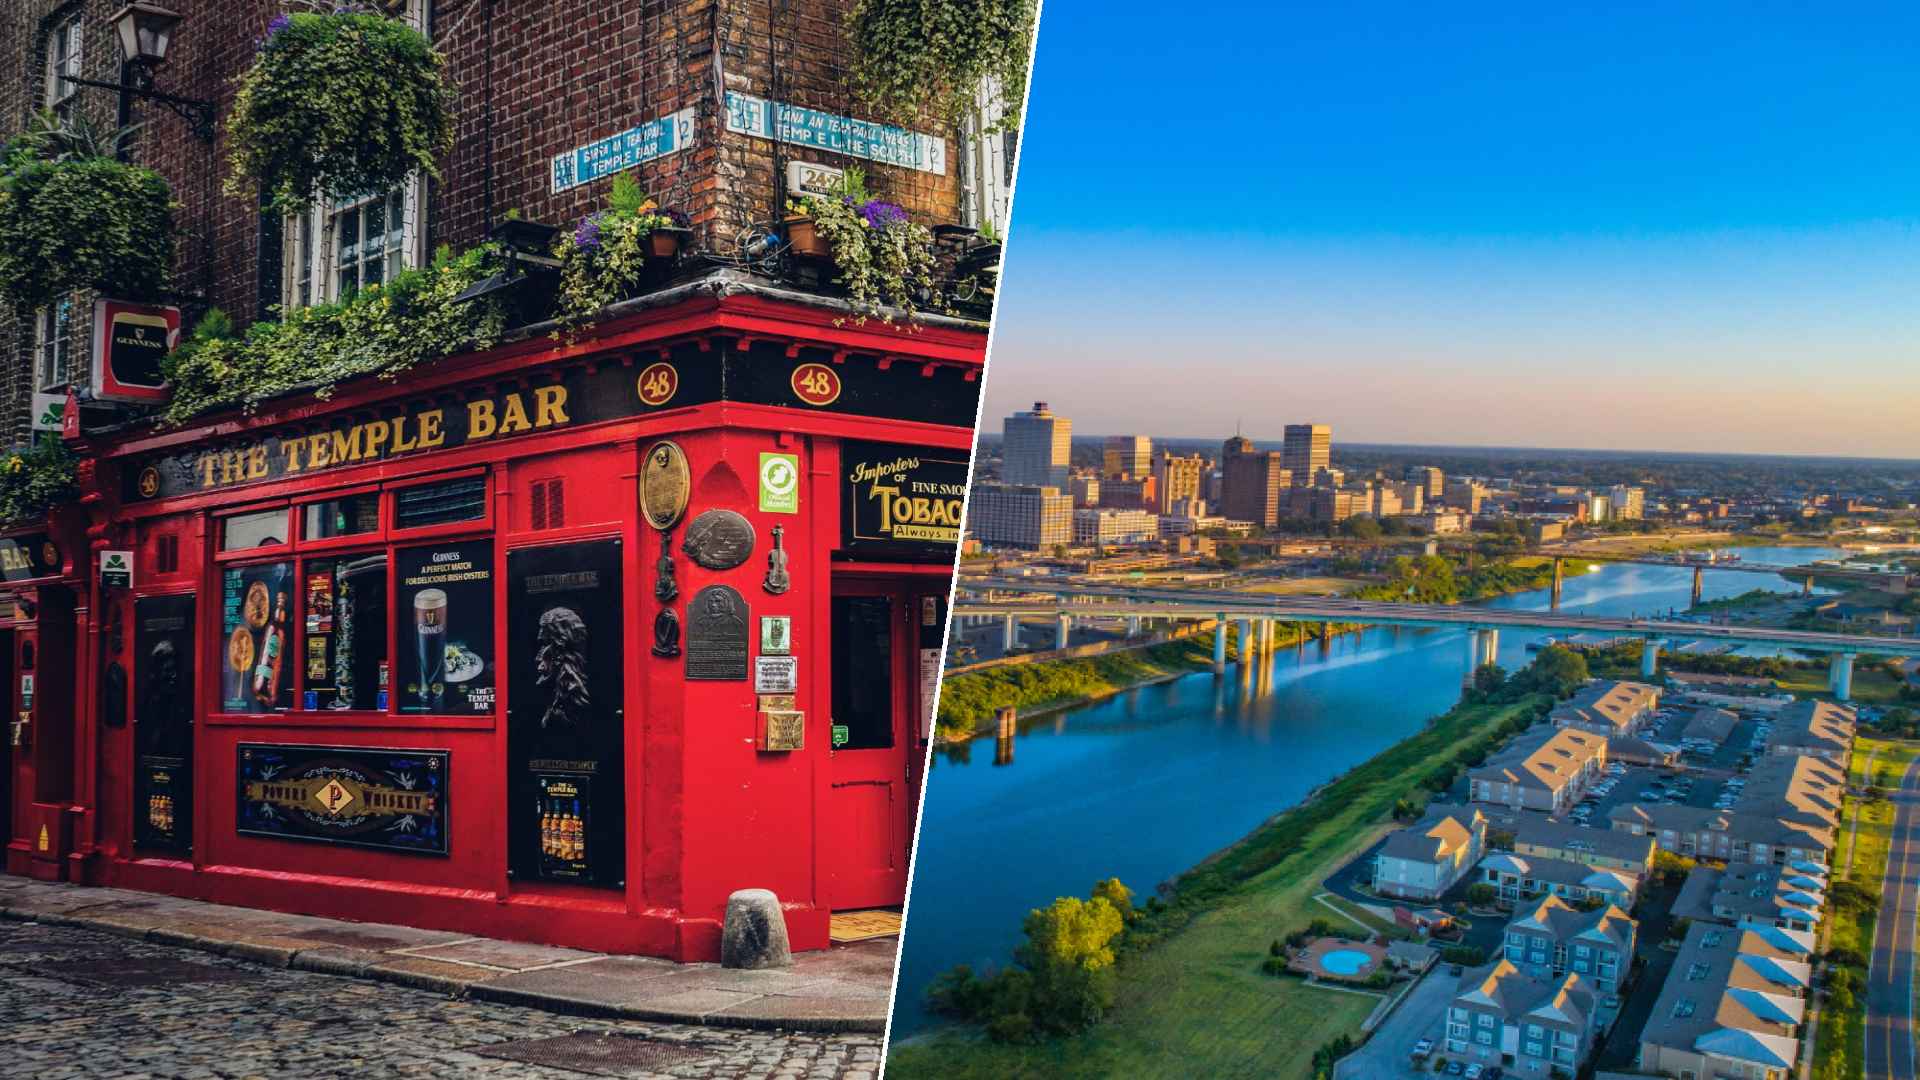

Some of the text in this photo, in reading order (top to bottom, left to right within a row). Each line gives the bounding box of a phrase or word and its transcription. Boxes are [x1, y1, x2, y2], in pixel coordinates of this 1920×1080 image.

[679, 120, 689, 139] 2
[808, 115, 824, 129] AN
[776, 123, 826, 145] TEMPE
[592, 150, 632, 175] TEMPLE
[636, 142, 658, 159] BAR
[116, 336, 162, 348] GUINNESS
[643, 371, 670, 398] 48
[800, 369, 831, 395] 48
[200, 384, 570, 487] THE TEMPLE BAR
[850, 457, 920, 485] Importers
[894, 474, 907, 483] OF
[912, 481, 938, 493] FINE
[896, 525, 941, 539] Always
[0, 546, 35, 571] BAR
[432, 552, 461, 562] GUINNESS
[427, 563, 450, 573] PERFECT
[451, 561, 472, 571] MATCH
[405, 570, 490, 585] FOR DELICIOUS IRISH OYSTERS
[467, 694, 495, 702] TEMPLE
[474, 702, 489, 710] BAR
[261, 783, 422, 810] POWERS P WHISKEY
